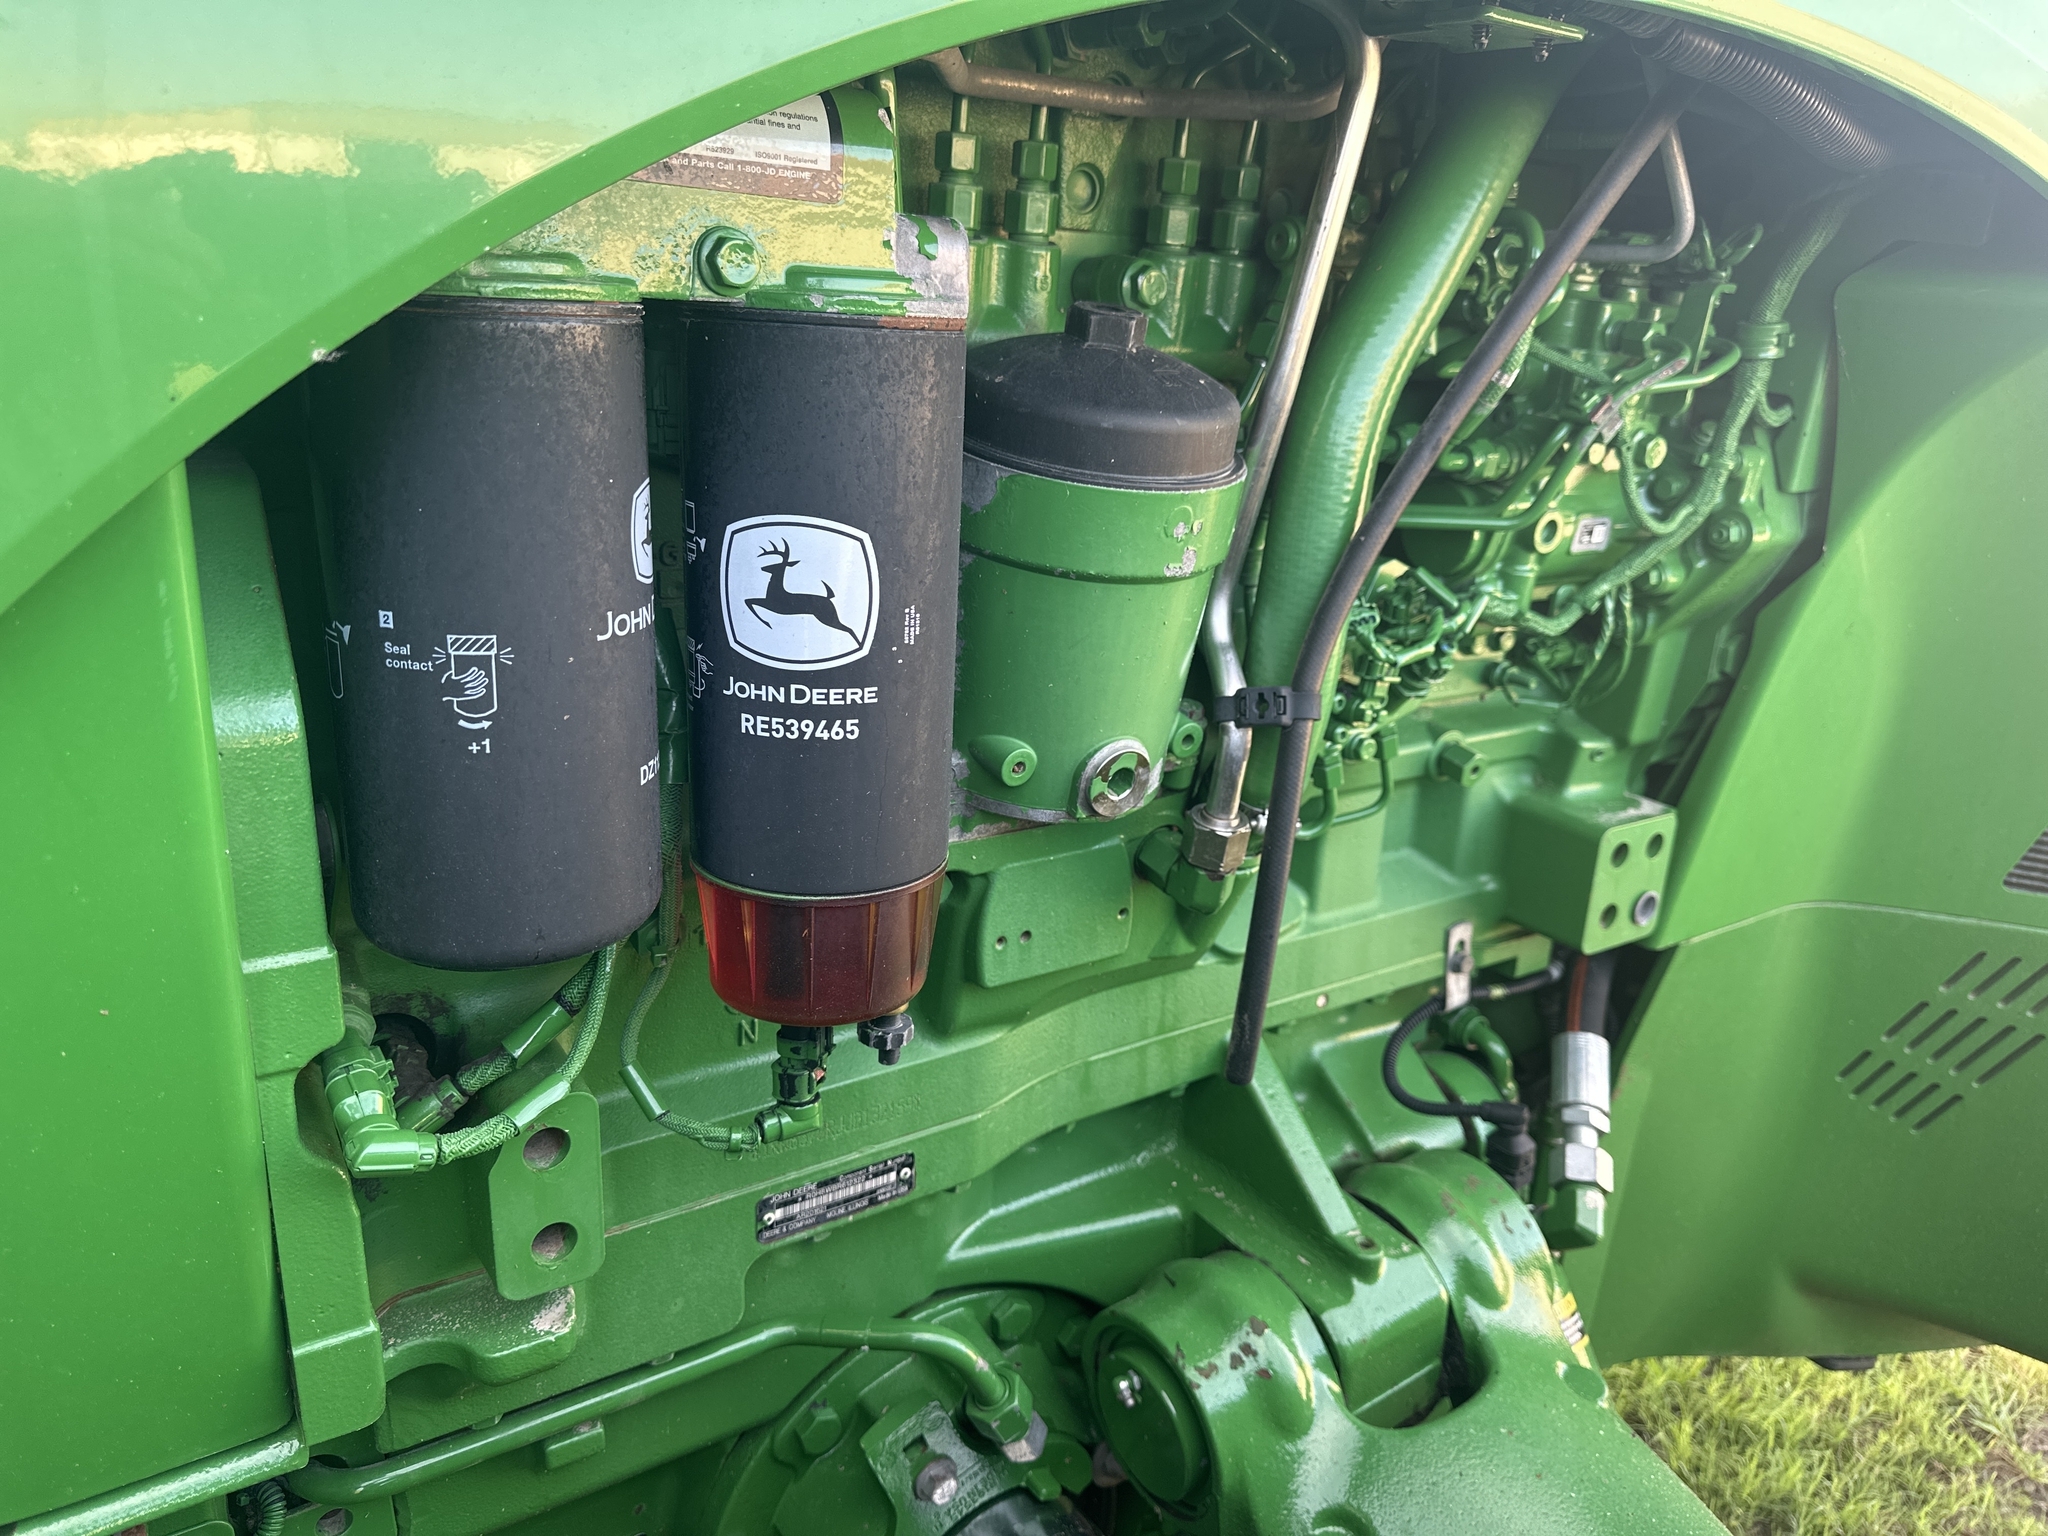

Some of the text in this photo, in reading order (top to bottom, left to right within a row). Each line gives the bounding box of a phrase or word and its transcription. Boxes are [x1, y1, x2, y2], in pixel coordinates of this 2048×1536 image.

[768, 119, 786, 129] fines
[787, 123, 801, 131] and
[779, 111, 819, 122] regulations
[755, 151, 782, 160] ISO9001
[784, 154, 818, 166] Registered
[671, 157, 689, 166] and
[691, 158, 715, 169] Parts
[717, 161, 734, 171] Call
[737, 164, 776, 175] 1-800-JD
[778, 168, 812, 180] ENGINE
[597, 603, 651, 641] JOHN
[384, 641, 411, 655] Seal
[385, 658, 434, 672] contact
[723, 676, 878, 705] JOHN DEERE
[741, 713, 860, 741] RE539465
[468, 738, 491, 754] +1
[770, 1182, 818, 1203] JOHN DEERE
[762, 1228, 781, 1239] DEERE
[789, 1217, 817, 1231] COMPANY
